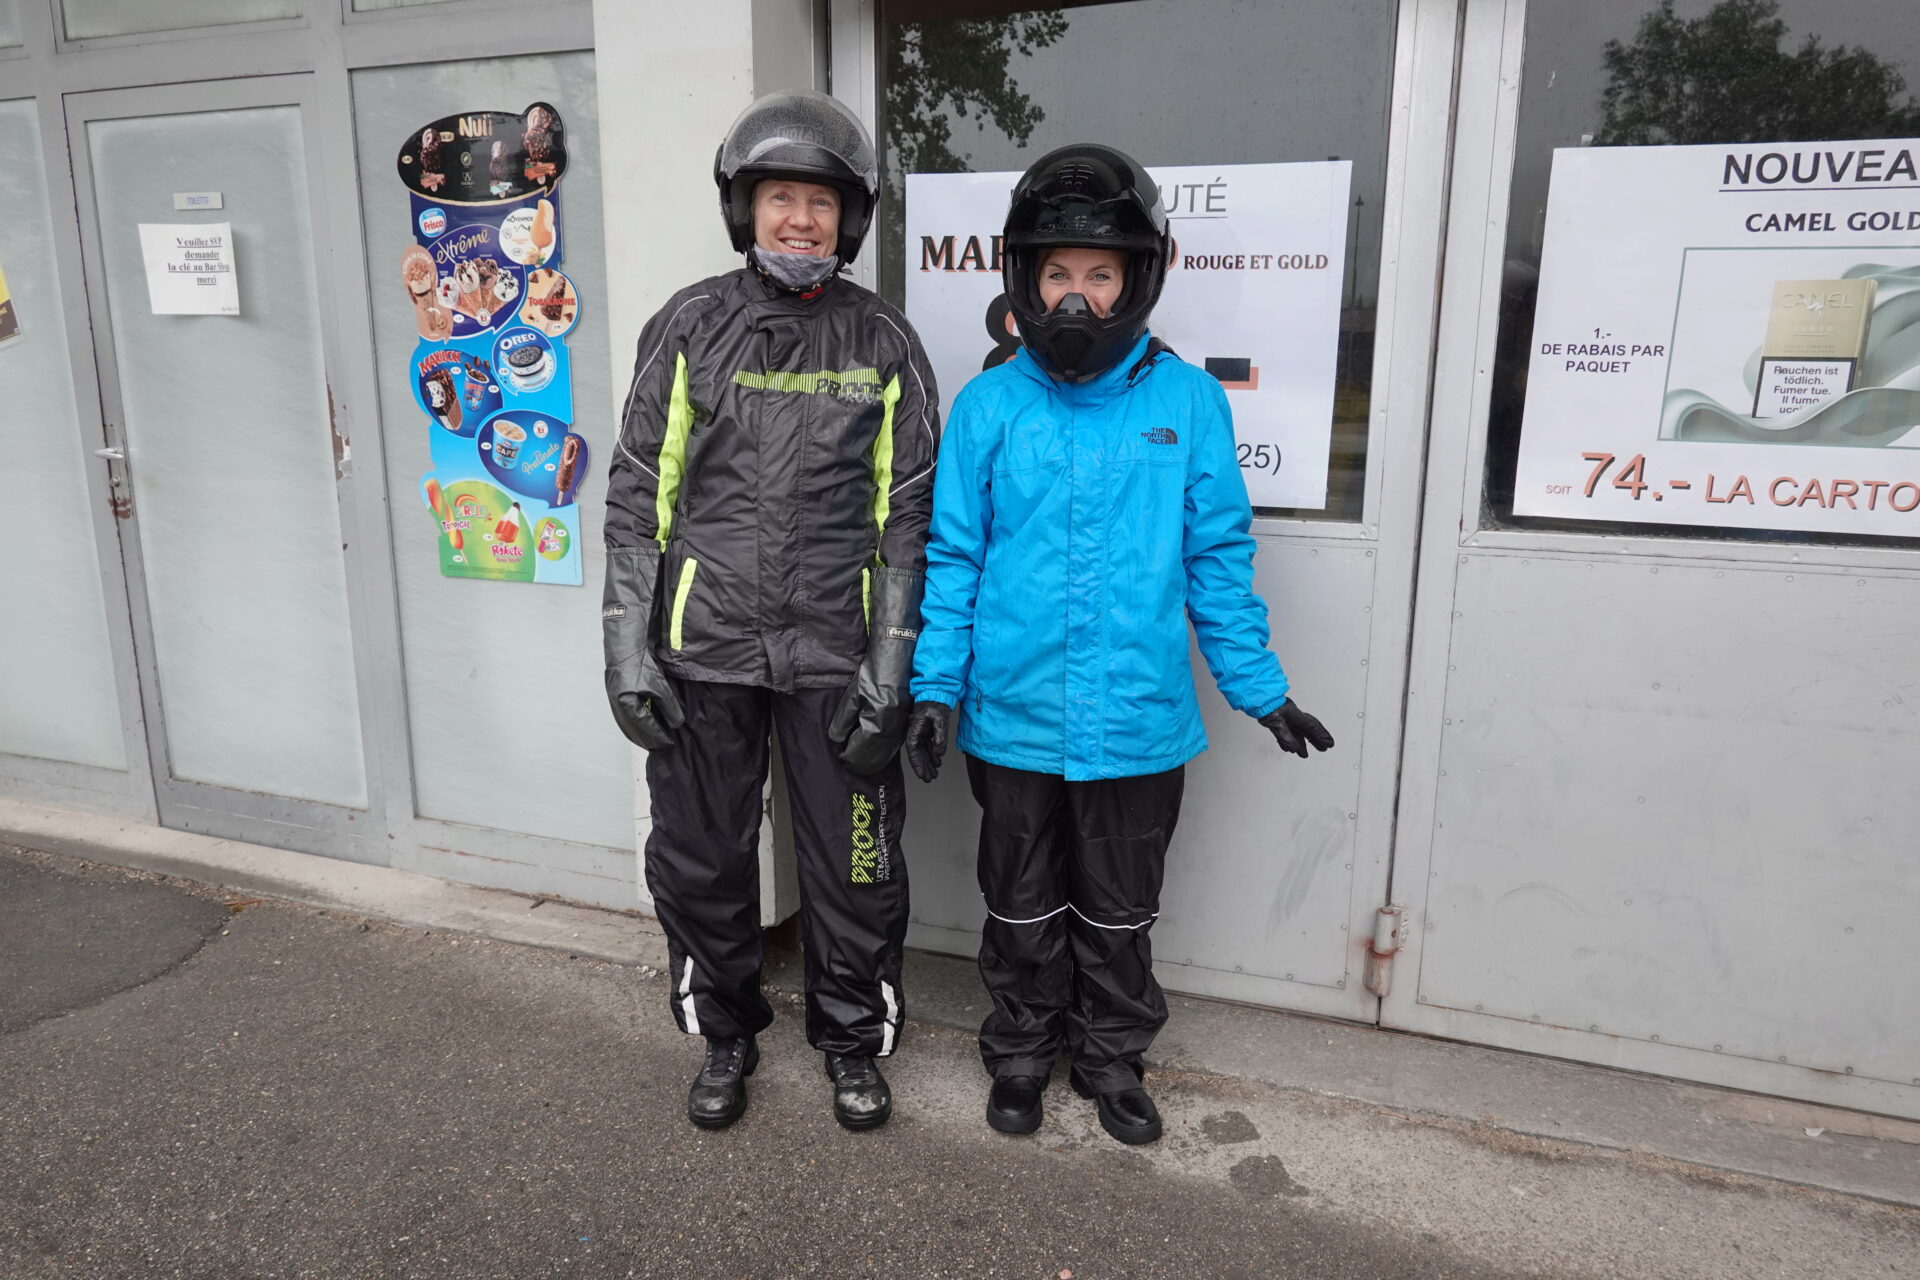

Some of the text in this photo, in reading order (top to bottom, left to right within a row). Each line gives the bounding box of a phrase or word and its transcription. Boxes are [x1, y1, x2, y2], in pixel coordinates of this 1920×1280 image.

[1723, 150, 1918, 185] NOUVEA
[423, 220, 444, 231] Frisco
[1746, 213, 1836, 232] CAMEL
[176, 237, 208, 246] Veuillez
[179, 262, 191, 270] clé
[1183, 254, 1329, 270] ROUGE ET GOLD
[1781, 293, 1853, 309] CAMEL
[500, 333, 537, 350] OREO
[1541, 344, 1664, 356] DE RABAIS PAR
[1566, 361, 1630, 373] PAQUET
[1773, 366, 1839, 375] Rauchen ist
[1784, 376, 1824, 385] tödlich.
[1773, 386, 1831, 395] Fumer tue.
[1546, 452, 1920, 513] SOIT 74.- LA CARTO
[492, 545, 524, 557] Rakete
[851, 793, 878, 883] PROOF
